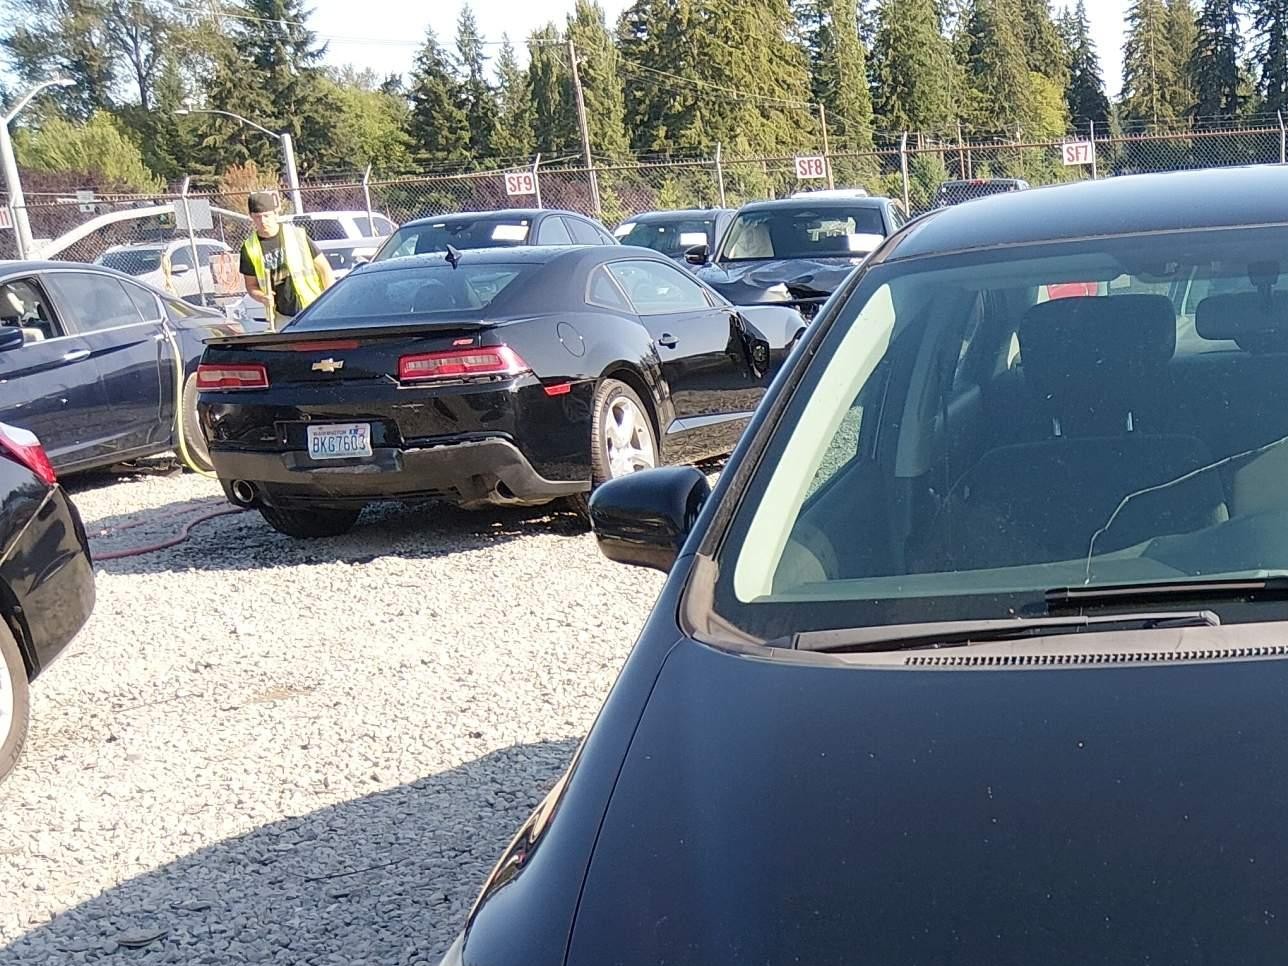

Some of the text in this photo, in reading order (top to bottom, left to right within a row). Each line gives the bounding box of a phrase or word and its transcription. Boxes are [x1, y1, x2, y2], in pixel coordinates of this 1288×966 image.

[1066, 144, 1088, 162] SF7
[798, 158, 823, 176] SF8
[507, 175, 533, 193] SF9
